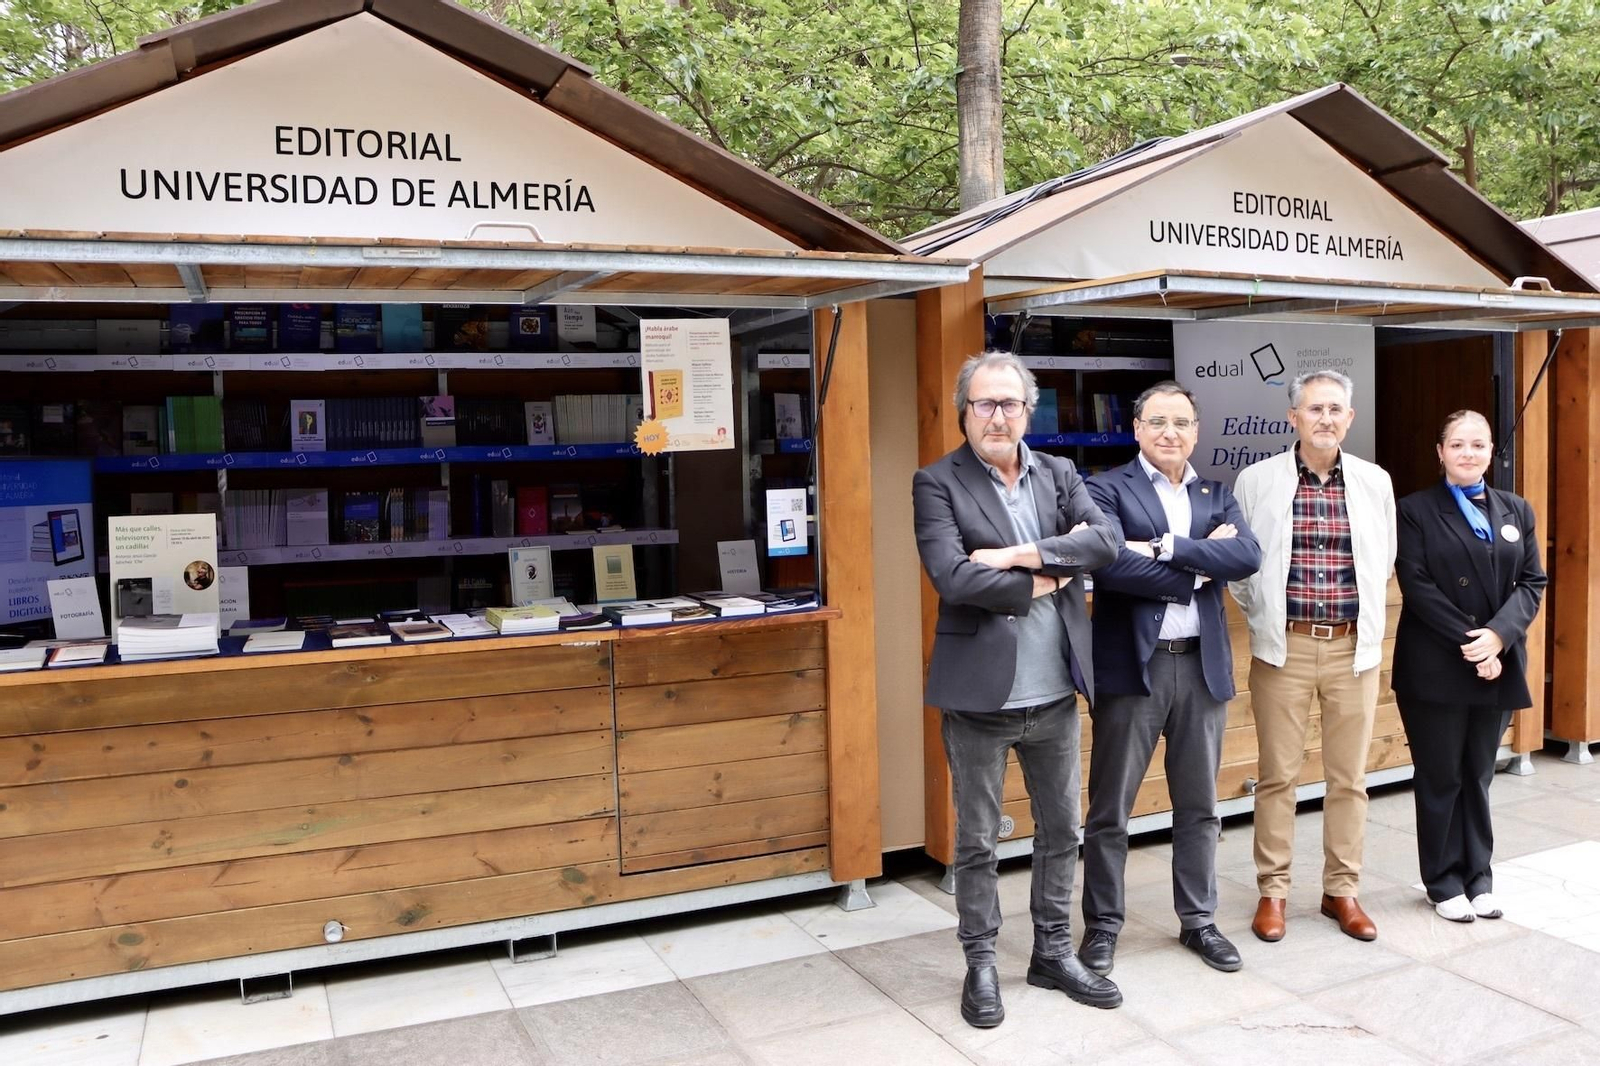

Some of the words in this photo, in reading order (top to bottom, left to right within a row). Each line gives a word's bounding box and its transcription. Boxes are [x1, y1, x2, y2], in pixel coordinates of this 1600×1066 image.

[275, 125, 462, 162] EDITORIAL
[120, 168, 378, 205] UNIVERSIDAD
[392, 178, 436, 207] DE
[448, 178, 596, 213] ALMERÍA
[1233, 191, 1333, 222] EDITORIAL
[1150, 220, 1289, 252] UNIVERSIDAD
[1296, 232, 1320, 255] DE
[1325, 235, 1404, 261] ALMERÍA
[1296, 347, 1330, 358] editorial
[1195, 359, 1244, 378] edual
[1296, 357, 1354, 369] UNIVERSIDAD
[1221, 415, 1294, 436] Editan
[643, 434, 660, 443] HOY
[129, 526, 142, 534] que
[9, 595, 40, 607] LIBROS
[60, 611, 95, 620] FOTOGRAFÍA
